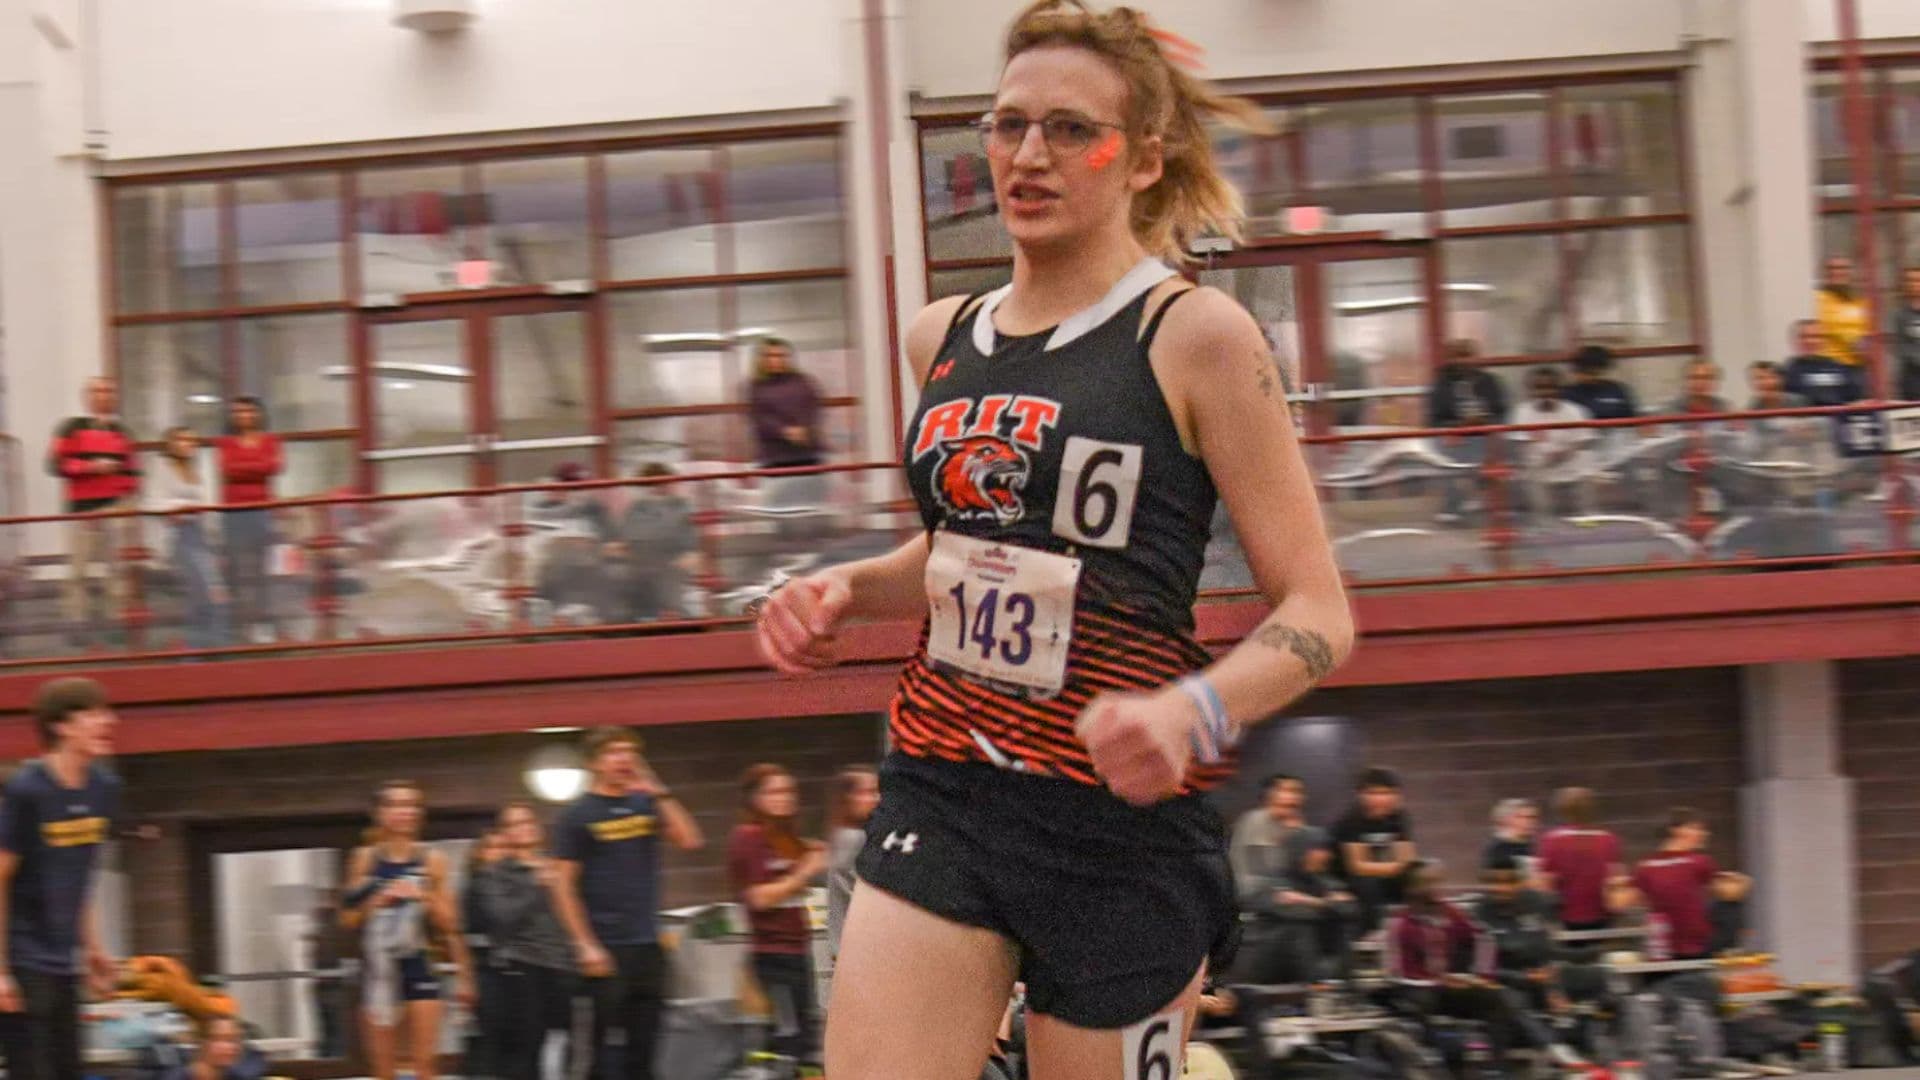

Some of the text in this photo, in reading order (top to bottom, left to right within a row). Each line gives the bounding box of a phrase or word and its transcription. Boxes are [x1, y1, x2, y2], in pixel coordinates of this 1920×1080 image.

[912, 395, 1061, 463] RIT
[1074, 450, 1124, 539] 6
[949, 581, 1036, 666] 143
[1138, 1021, 1170, 1080] 6
